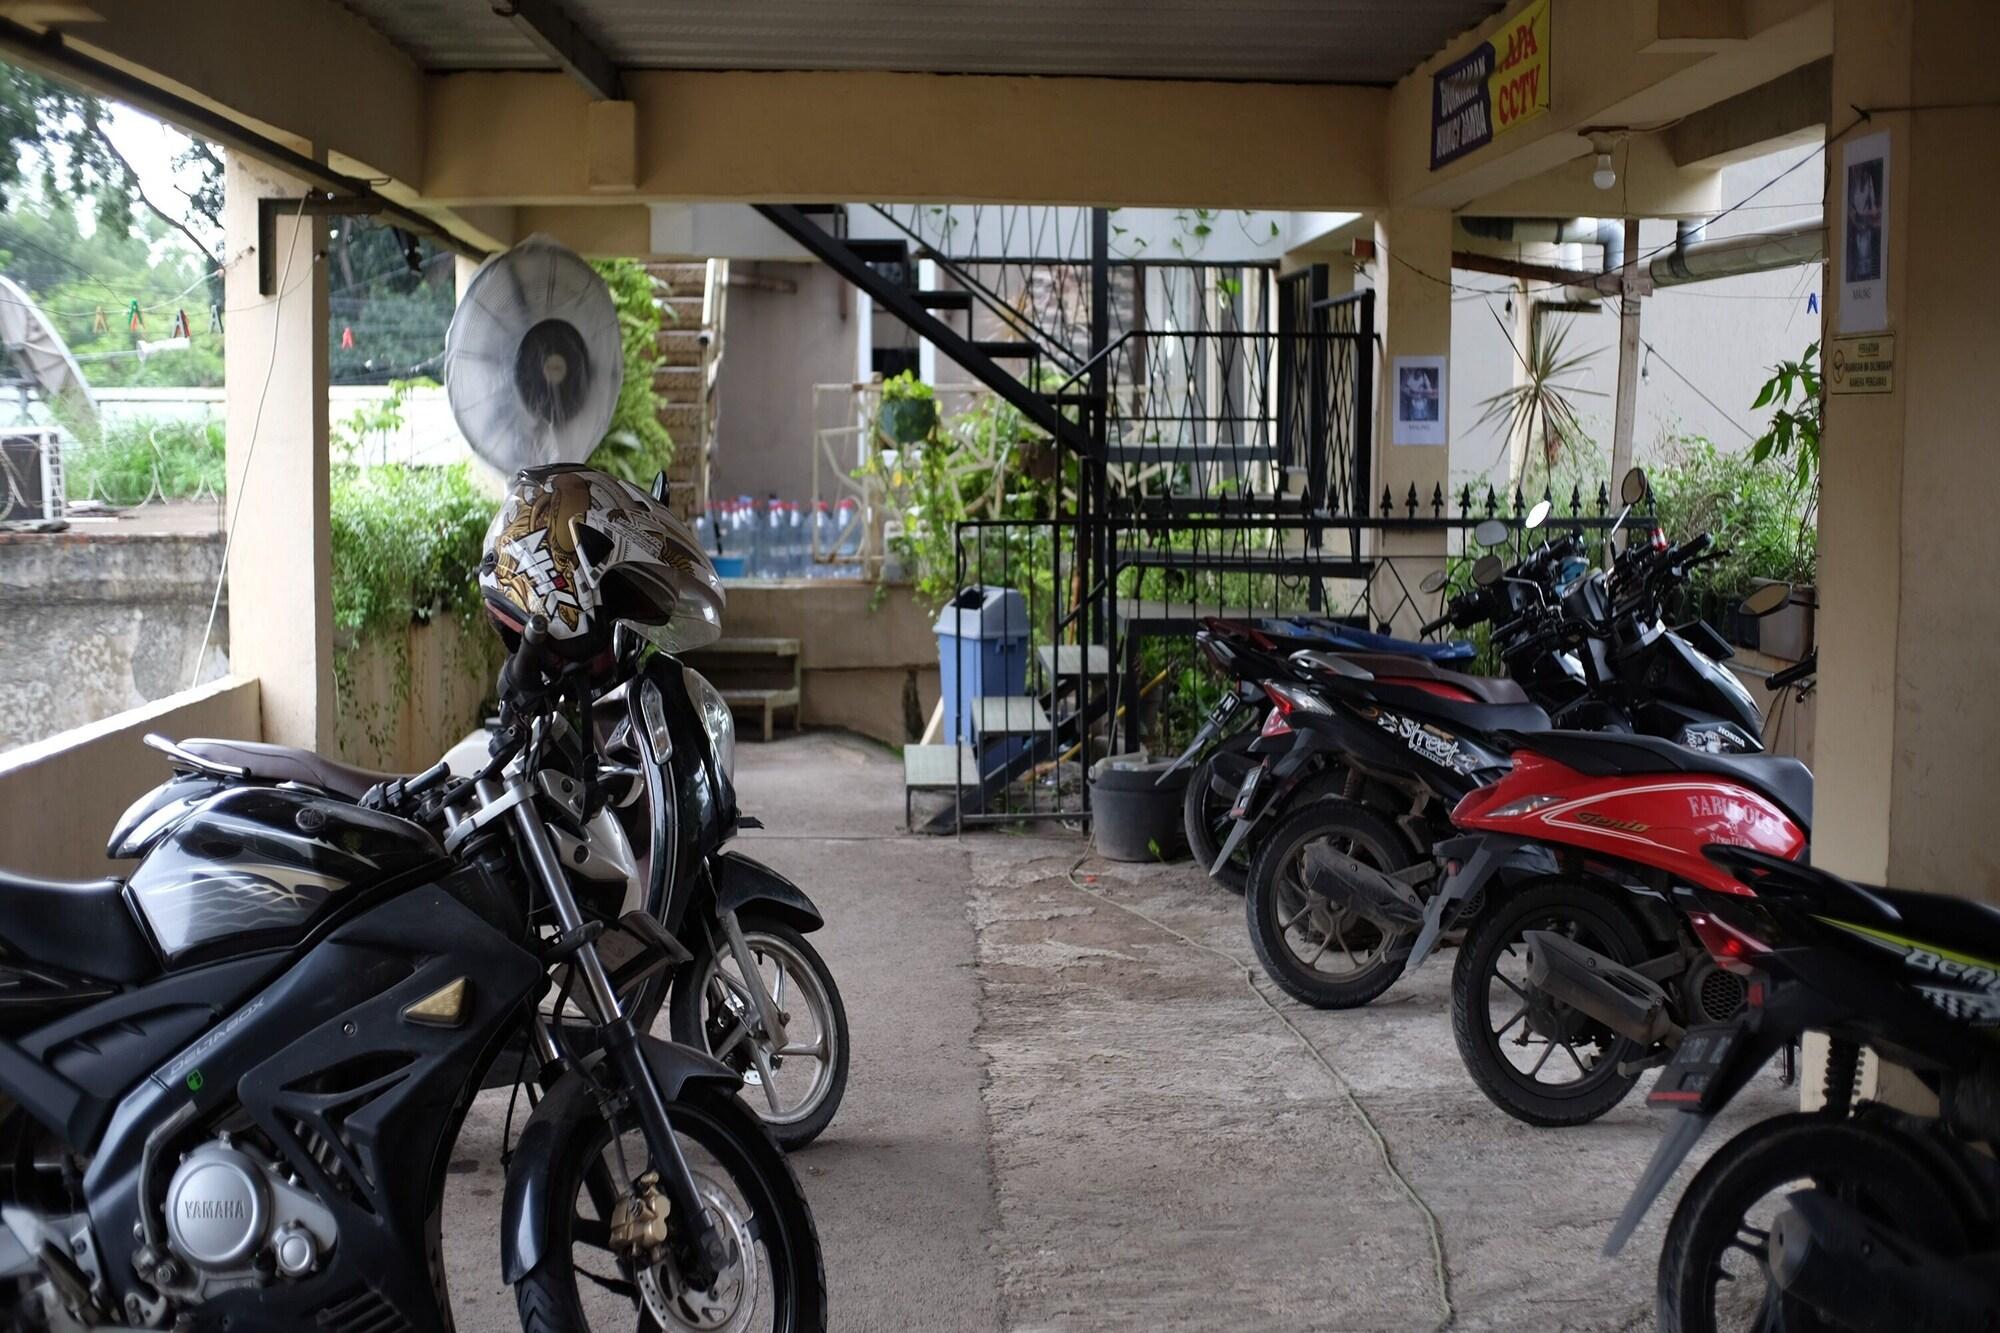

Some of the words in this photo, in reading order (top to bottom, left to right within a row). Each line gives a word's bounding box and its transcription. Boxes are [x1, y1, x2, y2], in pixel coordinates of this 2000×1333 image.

[1498, 63, 1541, 126] CCTV
[1399, 716, 1461, 767] Street
[1717, 725, 1746, 748] HONDA
[170, 996, 265, 1076] DELTABOX
[184, 1200, 246, 1220] YAMAHA
